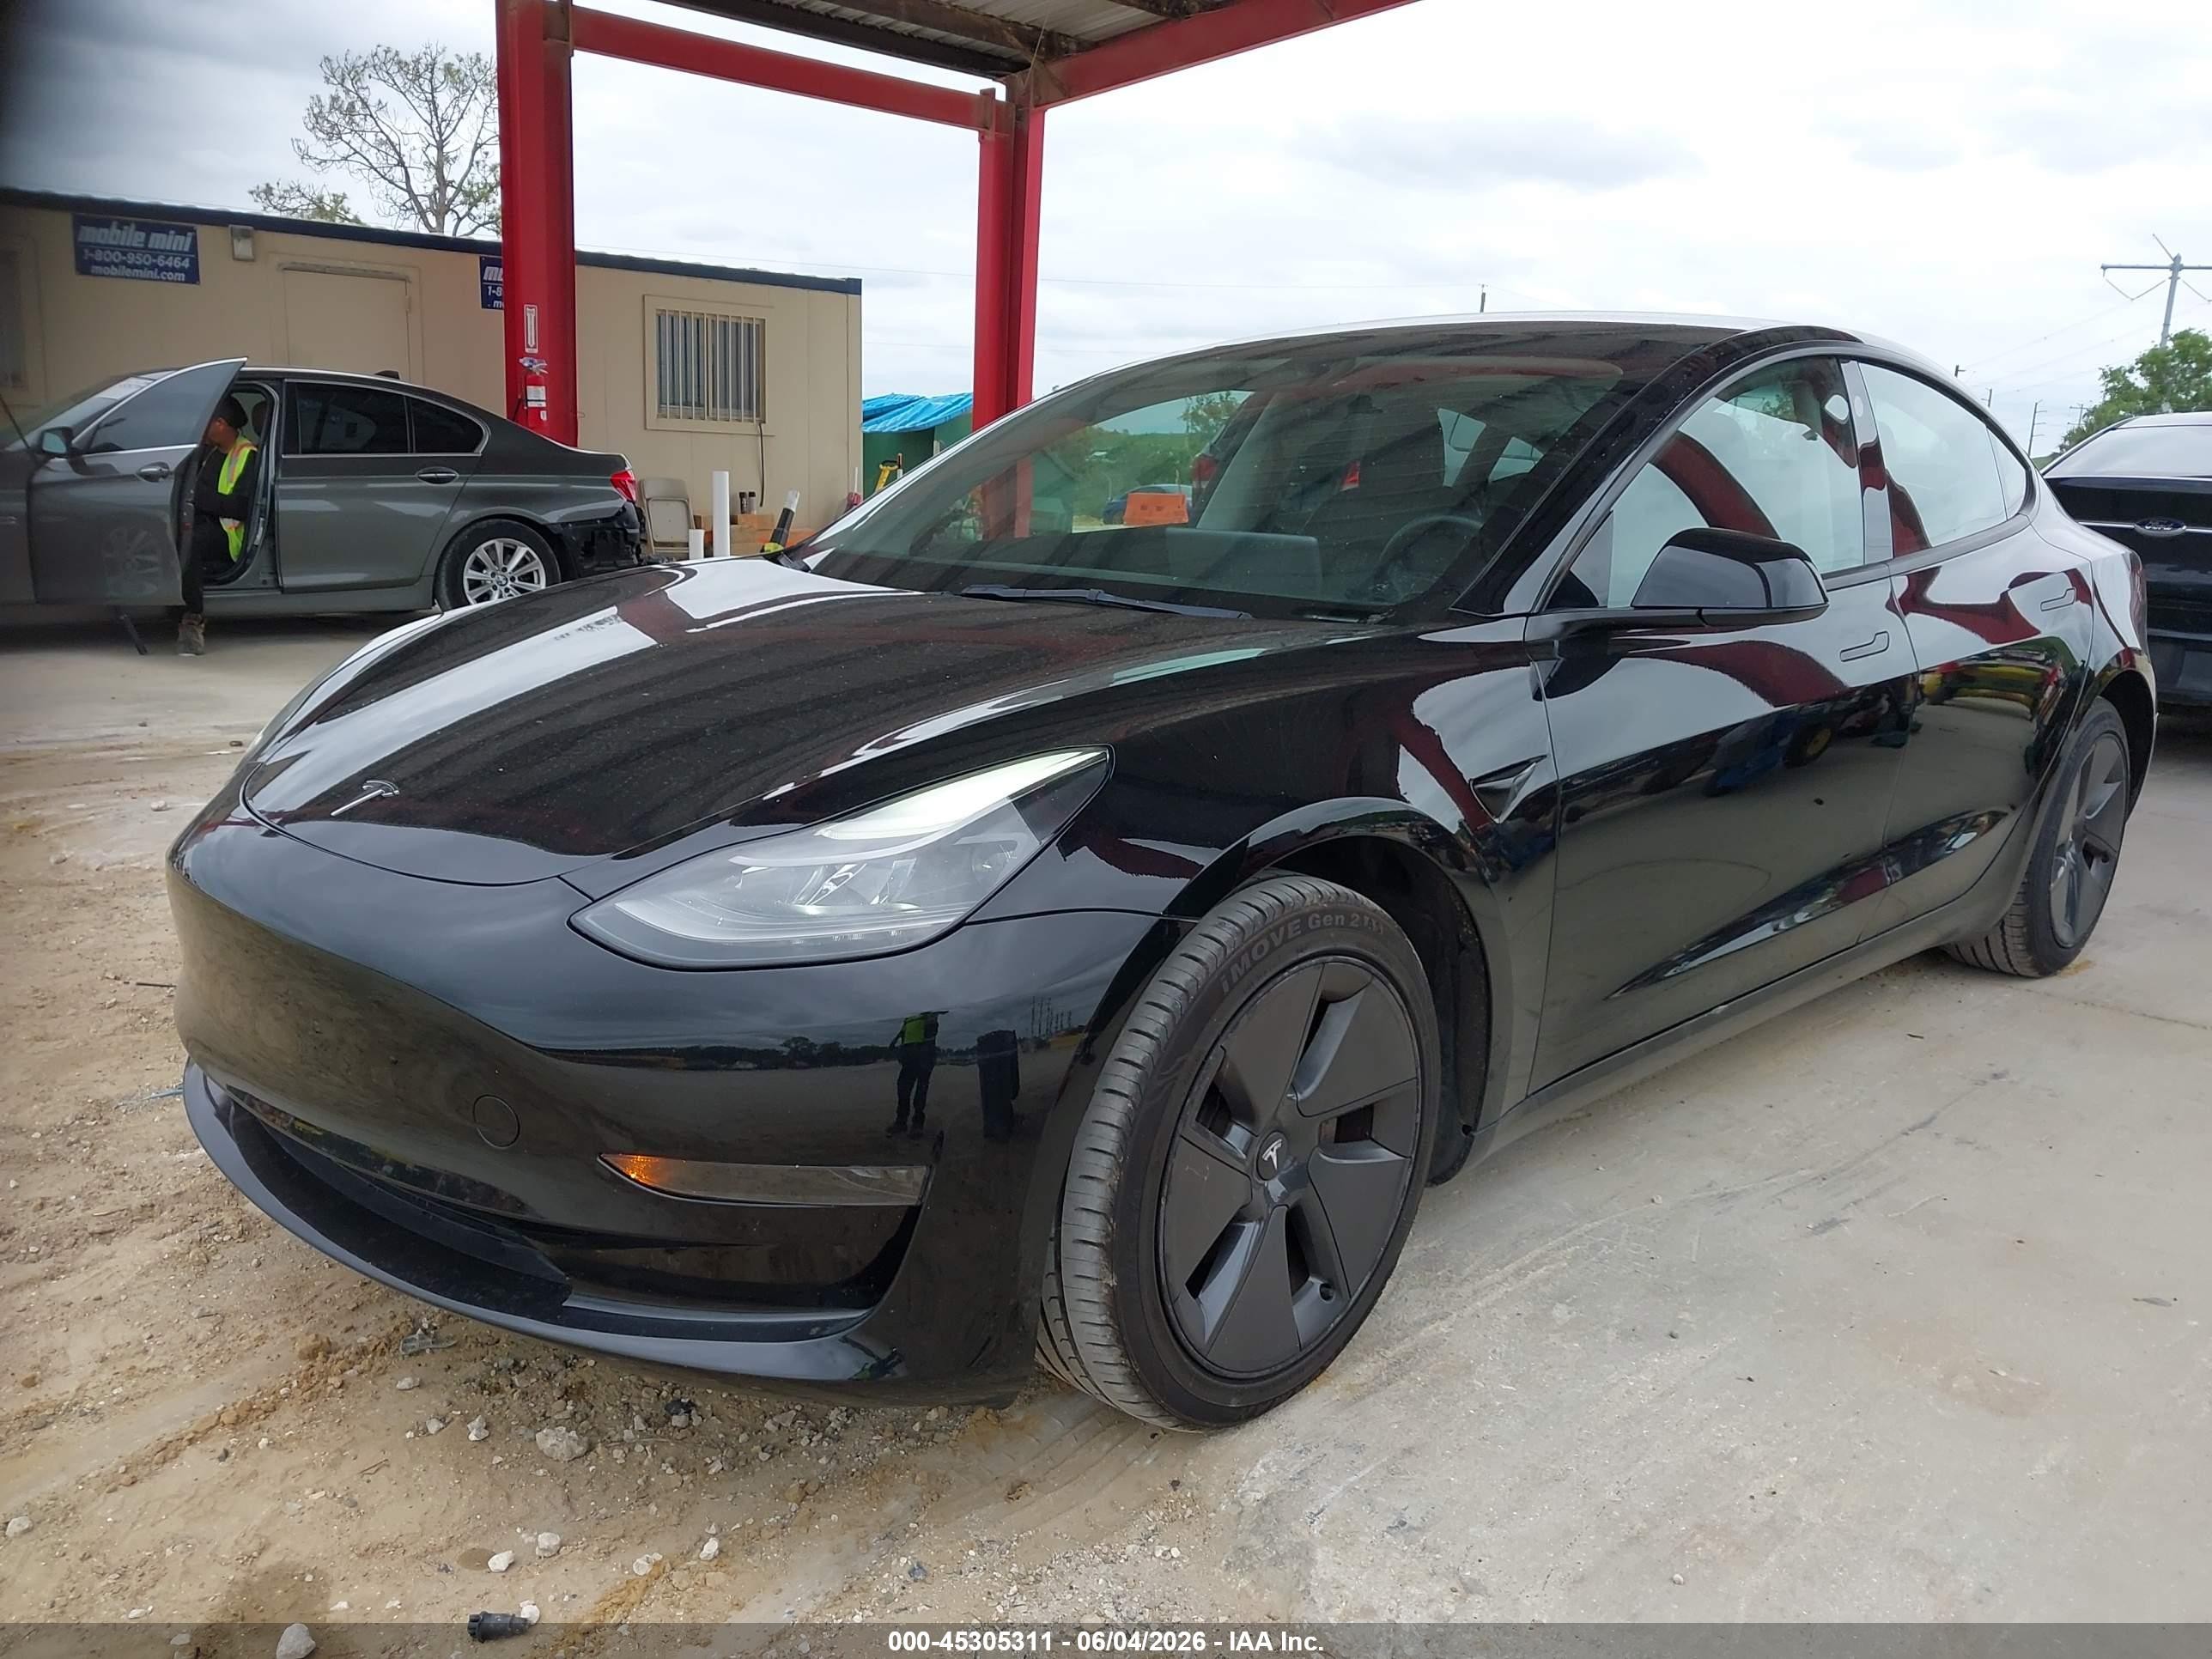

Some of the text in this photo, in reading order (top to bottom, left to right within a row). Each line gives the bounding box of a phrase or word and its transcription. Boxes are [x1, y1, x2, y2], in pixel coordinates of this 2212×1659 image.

[78, 221, 194, 252] mobile mini
[83, 249, 190, 269] 1-800-950-6464
[91, 264, 185, 282] mobilemini.com
[1221, 919, 1303, 994] iMOVE
[1308, 913, 1346, 929] Gen
[1349, 914, 1360, 927] 2
